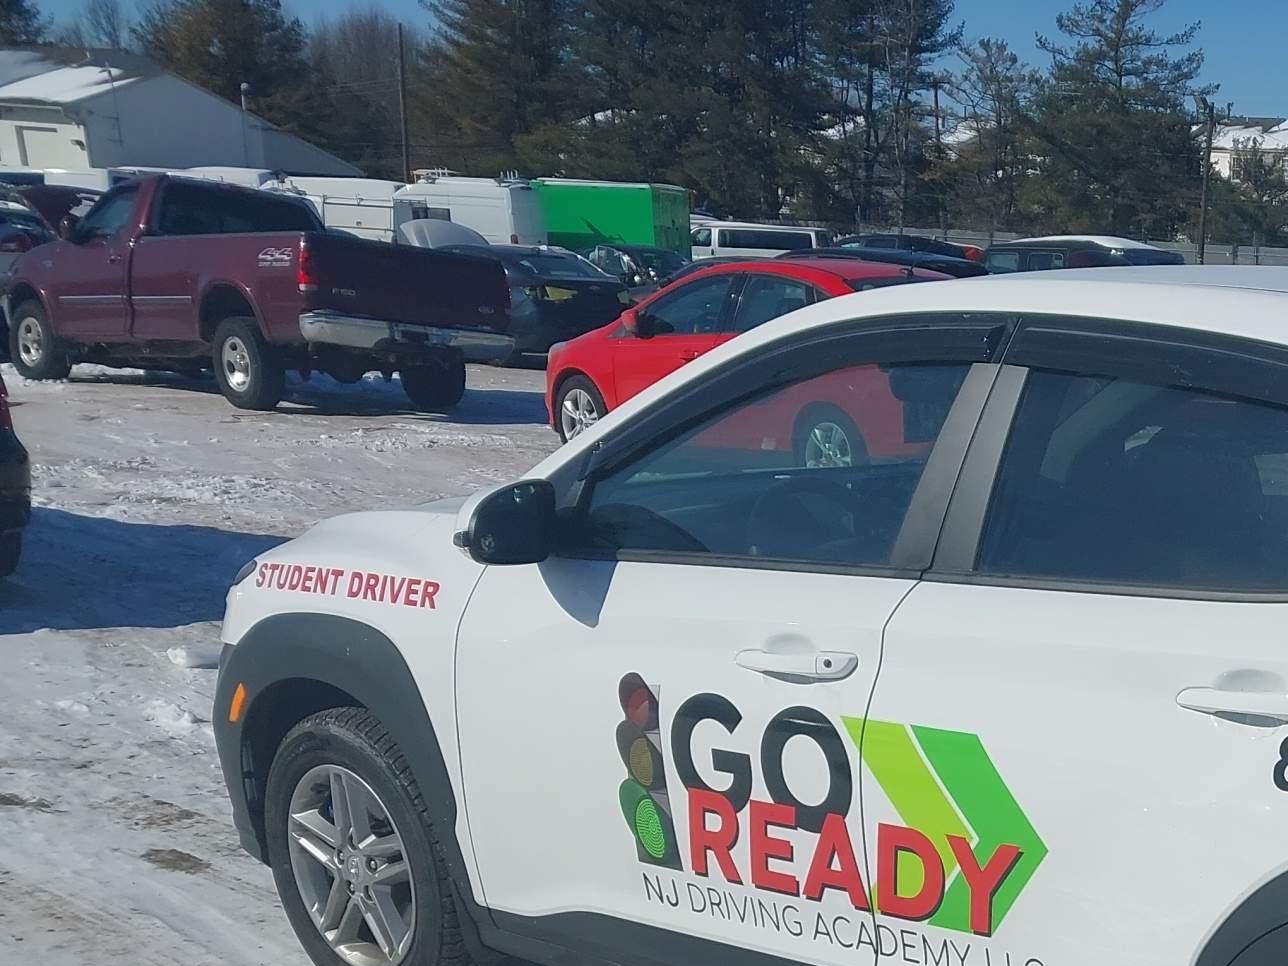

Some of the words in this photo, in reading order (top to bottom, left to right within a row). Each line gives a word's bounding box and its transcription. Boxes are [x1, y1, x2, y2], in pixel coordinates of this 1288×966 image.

[255, 563, 345, 595] STUDENT
[347, 571, 440, 609] DRIVER
[670, 691, 853, 834] GO
[642, 871, 680, 908] NJ
[686, 882, 804, 937] DRIVING
[687, 786, 1024, 937] READY
